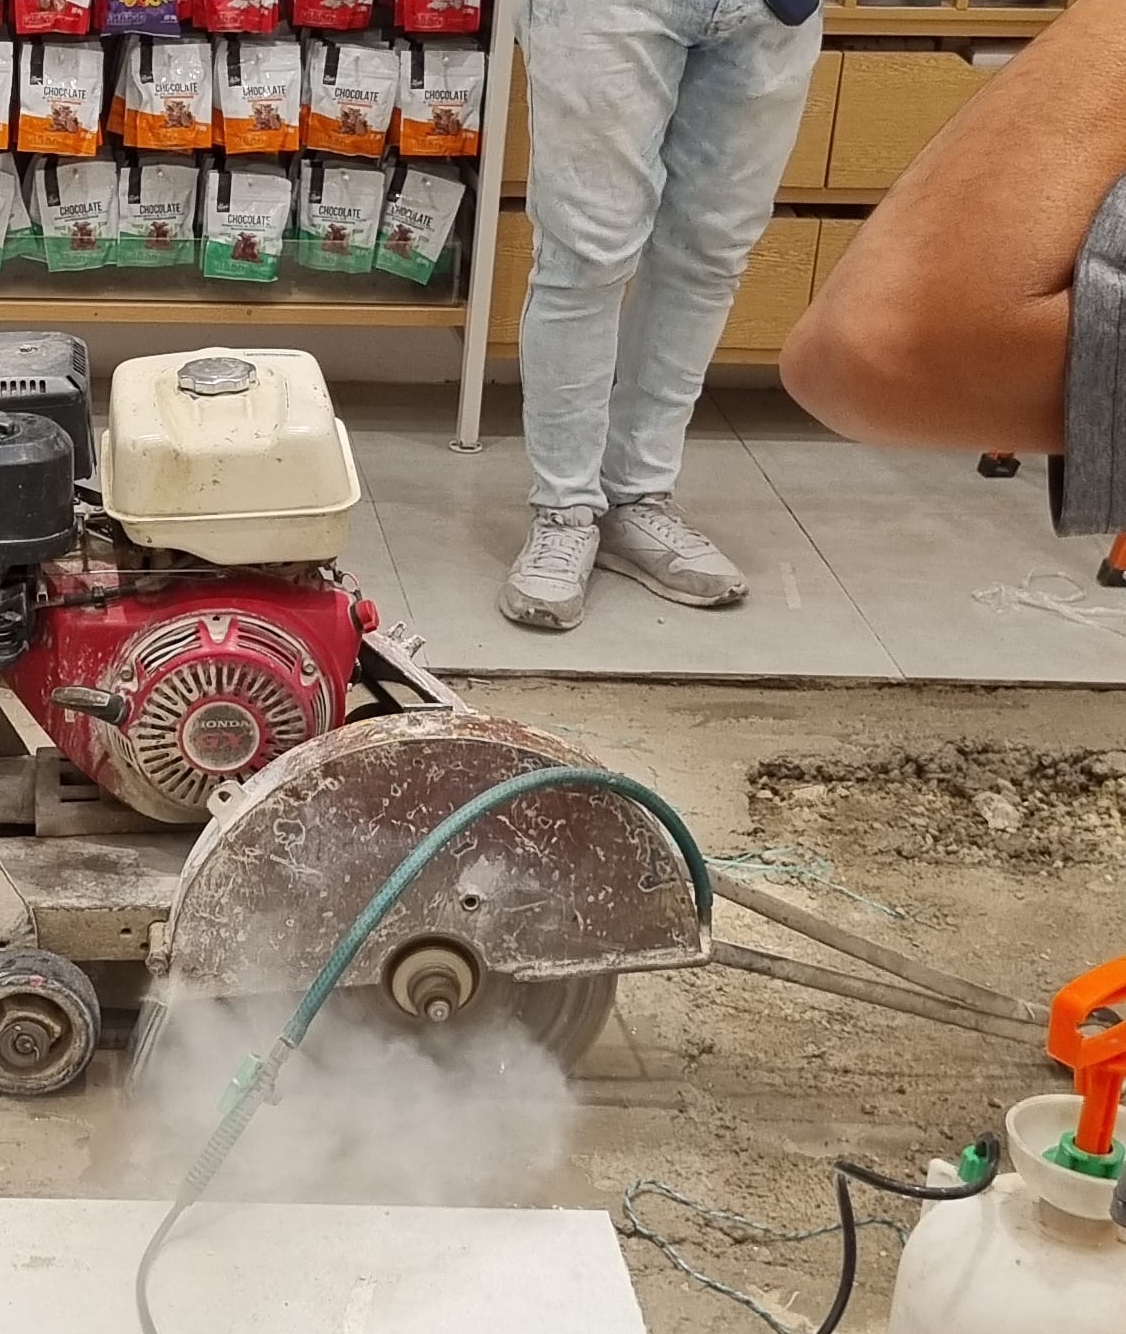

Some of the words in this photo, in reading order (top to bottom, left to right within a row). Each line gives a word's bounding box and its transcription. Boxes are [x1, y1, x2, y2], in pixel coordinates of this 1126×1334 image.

[43, 85, 88, 101] CHOCOLATE
[155, 82, 198, 93] CHOCOLATE
[242, 84, 287, 97] CHOCOLATE
[334, 86, 379, 103] CHOCOLATE
[424, 88, 469, 101] CHOCOLATE
[59, 201, 103, 216] CHOCOLATE
[139, 203, 181, 215] CHOCOLATE
[318, 204, 362, 219] CHOCOLATE
[227, 214, 272, 227] CHOCOLATE
[391, 205, 433, 228] CHOCOLATE
